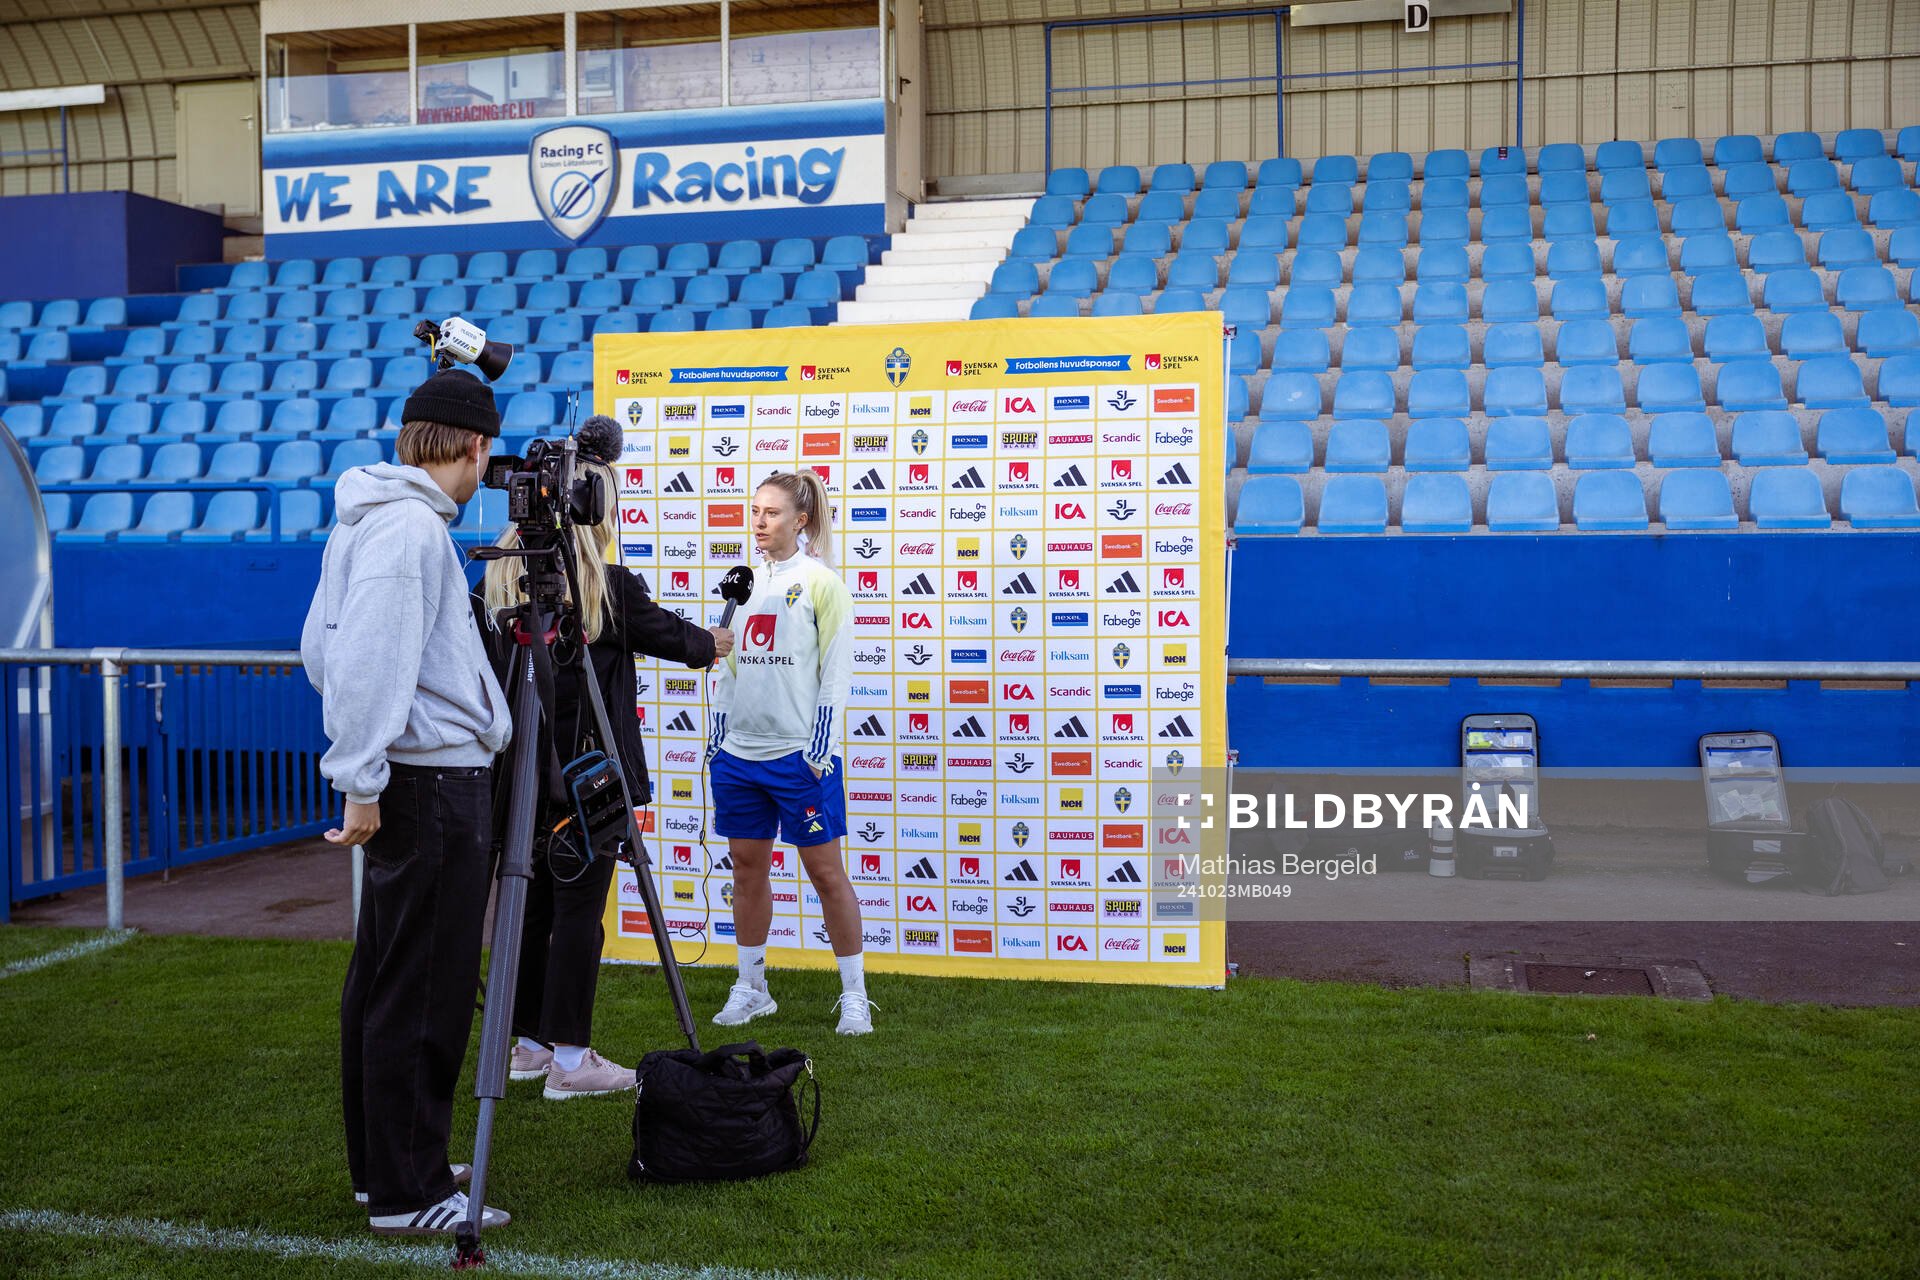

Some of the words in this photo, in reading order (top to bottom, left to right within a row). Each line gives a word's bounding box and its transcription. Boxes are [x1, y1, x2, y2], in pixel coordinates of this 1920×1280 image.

[1408, 5, 1427, 28] D
[541, 146, 583, 158] Racing
[588, 144, 603, 154] FC
[632, 147, 845, 209] Racing
[274, 172, 352, 222] WE
[375, 166, 491, 220] ARE
[1016, 362, 1058, 372] Fotbollens
[1060, 360, 1120, 372] huvudsponsor
[679, 371, 720, 379] Fotbollens
[721, 370, 779, 380] huvudsponsor
[1117, 390, 1127, 400] SJ
[665, 404, 696, 416] SPORT
[757, 406, 791, 415] Scandic
[806, 404, 840, 418] Fabege
[852, 404, 890, 414] Folksam
[1005, 398, 1036, 413] ICA
[721, 437, 731, 445] SJ
[854, 436, 887, 448] SPORT
[1003, 432, 1037, 444] SPORT
[1103, 433, 1140, 442] Scandic
[1155, 433, 1192, 446] Fabege
[623, 443, 651, 452] olksam
[1117, 500, 1126, 509] SJ
[623, 508, 649, 524] ICA
[664, 511, 696, 520] Scandic
[900, 509, 936, 518] Scandic
[950, 508, 986, 521] Fabege
[1000, 508, 1038, 516] Folksam
[1055, 503, 1086, 519] ICA
[711, 544, 741, 554] SPORT
[862, 538, 872, 548] SJ
[1048, 543, 1092, 551] BAUHAUS
[1155, 541, 1192, 555] Fabege
[665, 546, 696, 559] Fabege
[723, 572, 740, 584] svt
[902, 613, 932, 628] ICA
[950, 616, 987, 625] Folksam
[1104, 615, 1140, 628] Fabege
[1158, 611, 1190, 626] ICA
[914, 645, 923, 654] SJ
[1051, 651, 1089, 660] Folksam
[738, 656, 766, 664] NSKA
[769, 656, 794, 665] SPEL
[854, 652, 885, 665] abege
[666, 679, 696, 690] SPORT
[851, 687, 887, 696] Folksam
[1004, 684, 1035, 700] ICA
[1050, 687, 1091, 696] Scandic
[1156, 688, 1194, 701] Fabege
[903, 755, 935, 766] SPORT
[1015, 753, 1024, 762] SJ
[1104, 760, 1142, 768] Scandic
[901, 794, 936, 802] Scandic
[951, 794, 987, 808] Fabege
[1001, 794, 1040, 804] Folksam
[666, 820, 698, 832] Fabege
[866, 823, 875, 832] SJ
[902, 829, 938, 838] Folksam
[1159, 828, 1190, 844] ICA
[907, 896, 937, 912] ICA
[953, 901, 988, 914] Fabege
[1017, 897, 1026, 906] SJ
[1106, 901, 1140, 912] SPORT
[863, 933, 891, 945] abege
[905, 930, 938, 942] SPORT
[1002, 936, 1041, 948] Folksam
[1057, 935, 1088, 951] ICA
